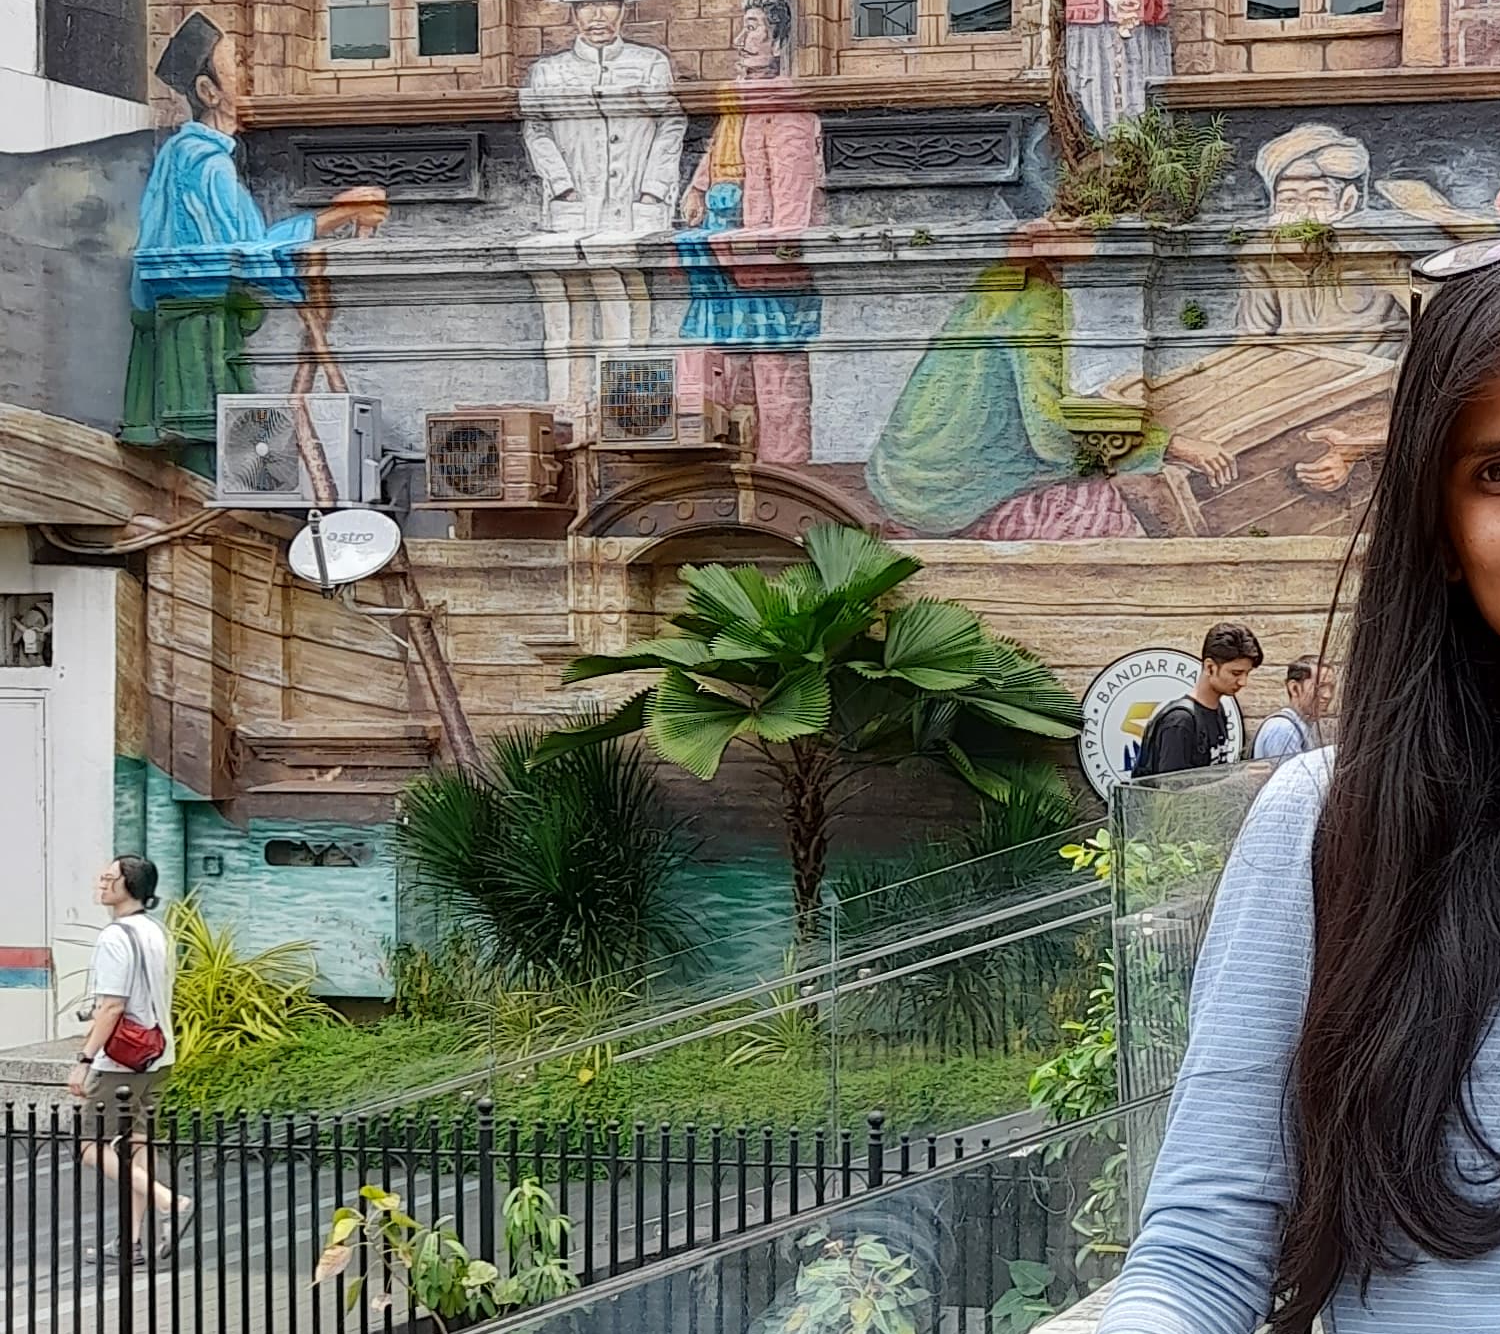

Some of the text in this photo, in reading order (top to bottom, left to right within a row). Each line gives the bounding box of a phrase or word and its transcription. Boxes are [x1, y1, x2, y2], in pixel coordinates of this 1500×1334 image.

[326, 532, 375, 543] astro
[1097, 658, 1168, 704] BANDAR
[1085, 717, 1099, 759] 1972
